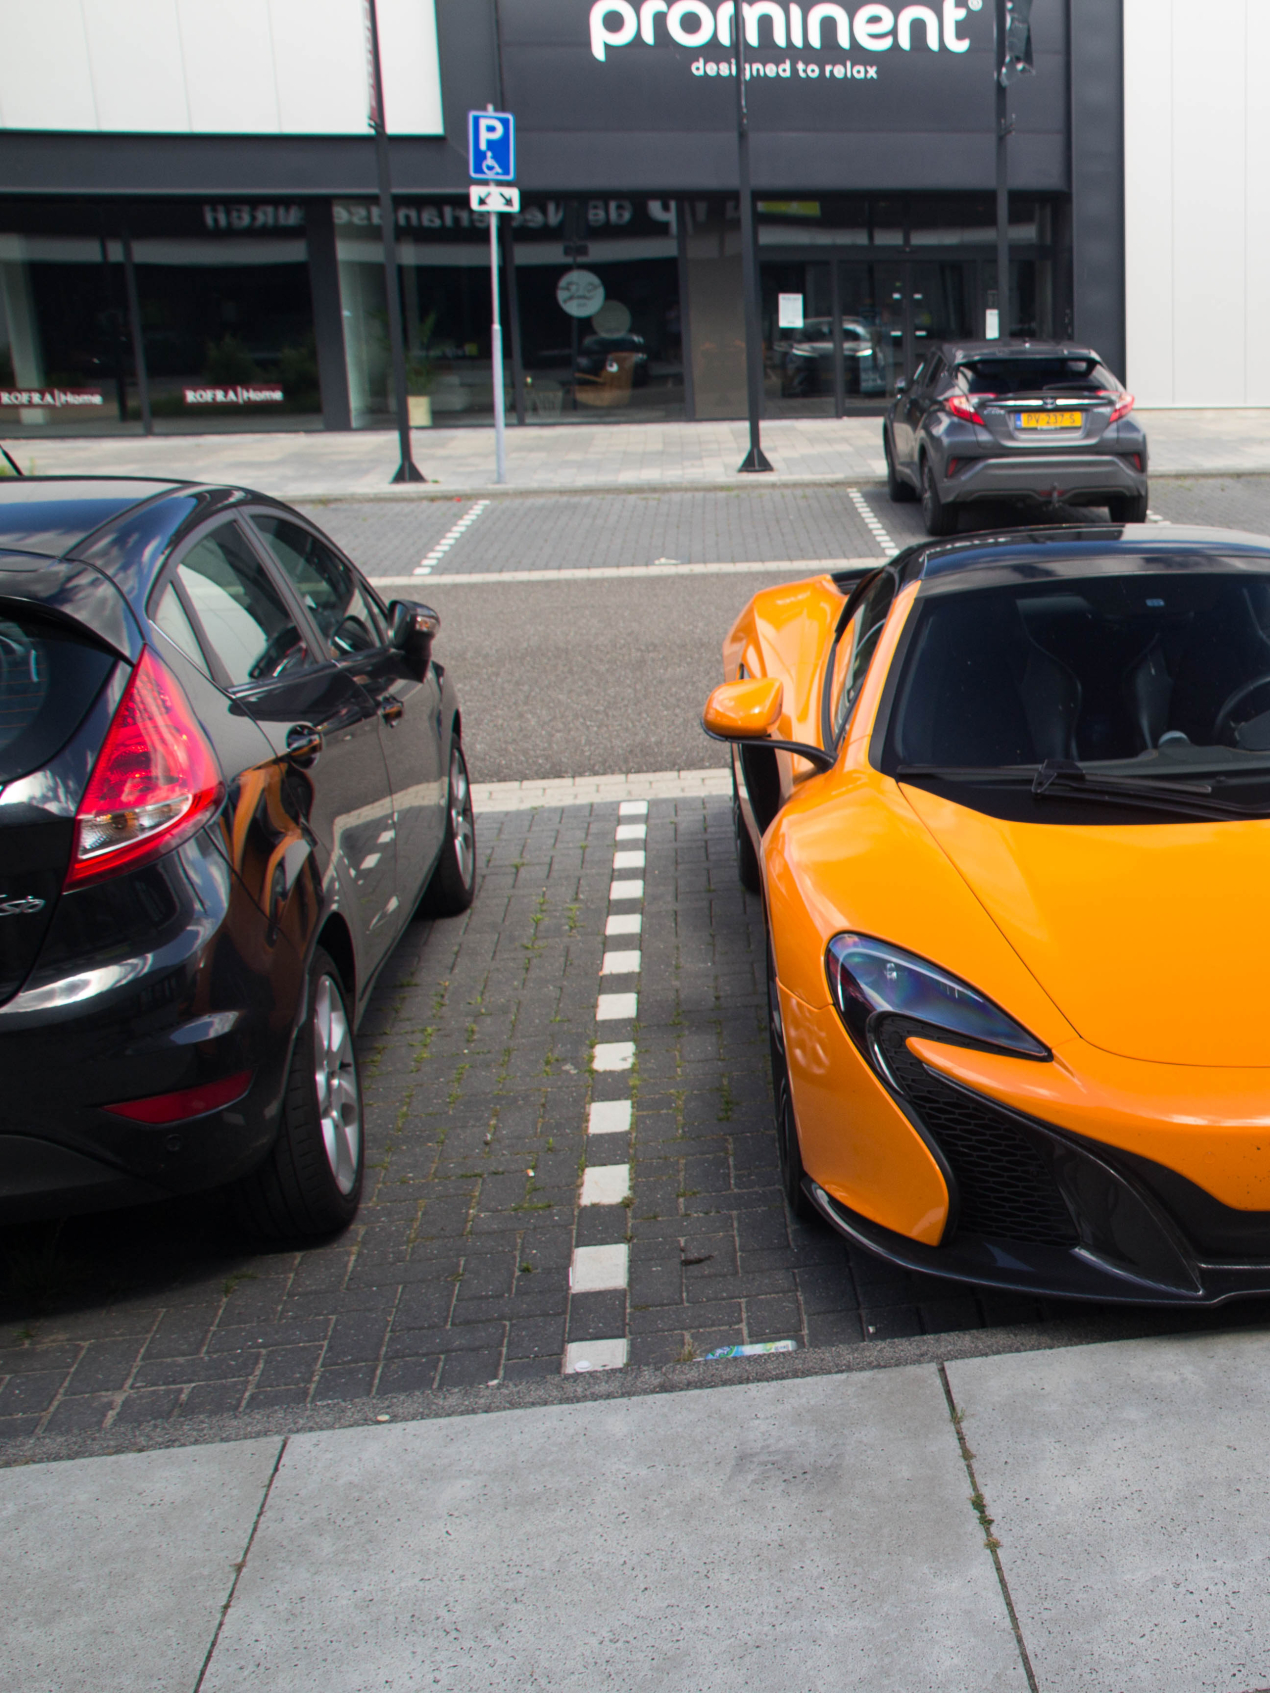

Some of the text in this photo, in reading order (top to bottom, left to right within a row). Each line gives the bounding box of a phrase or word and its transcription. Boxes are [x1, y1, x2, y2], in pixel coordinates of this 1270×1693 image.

[796, 60, 820, 79] to
[825, 59, 878, 80] relax
[479, 117, 504, 151] P
